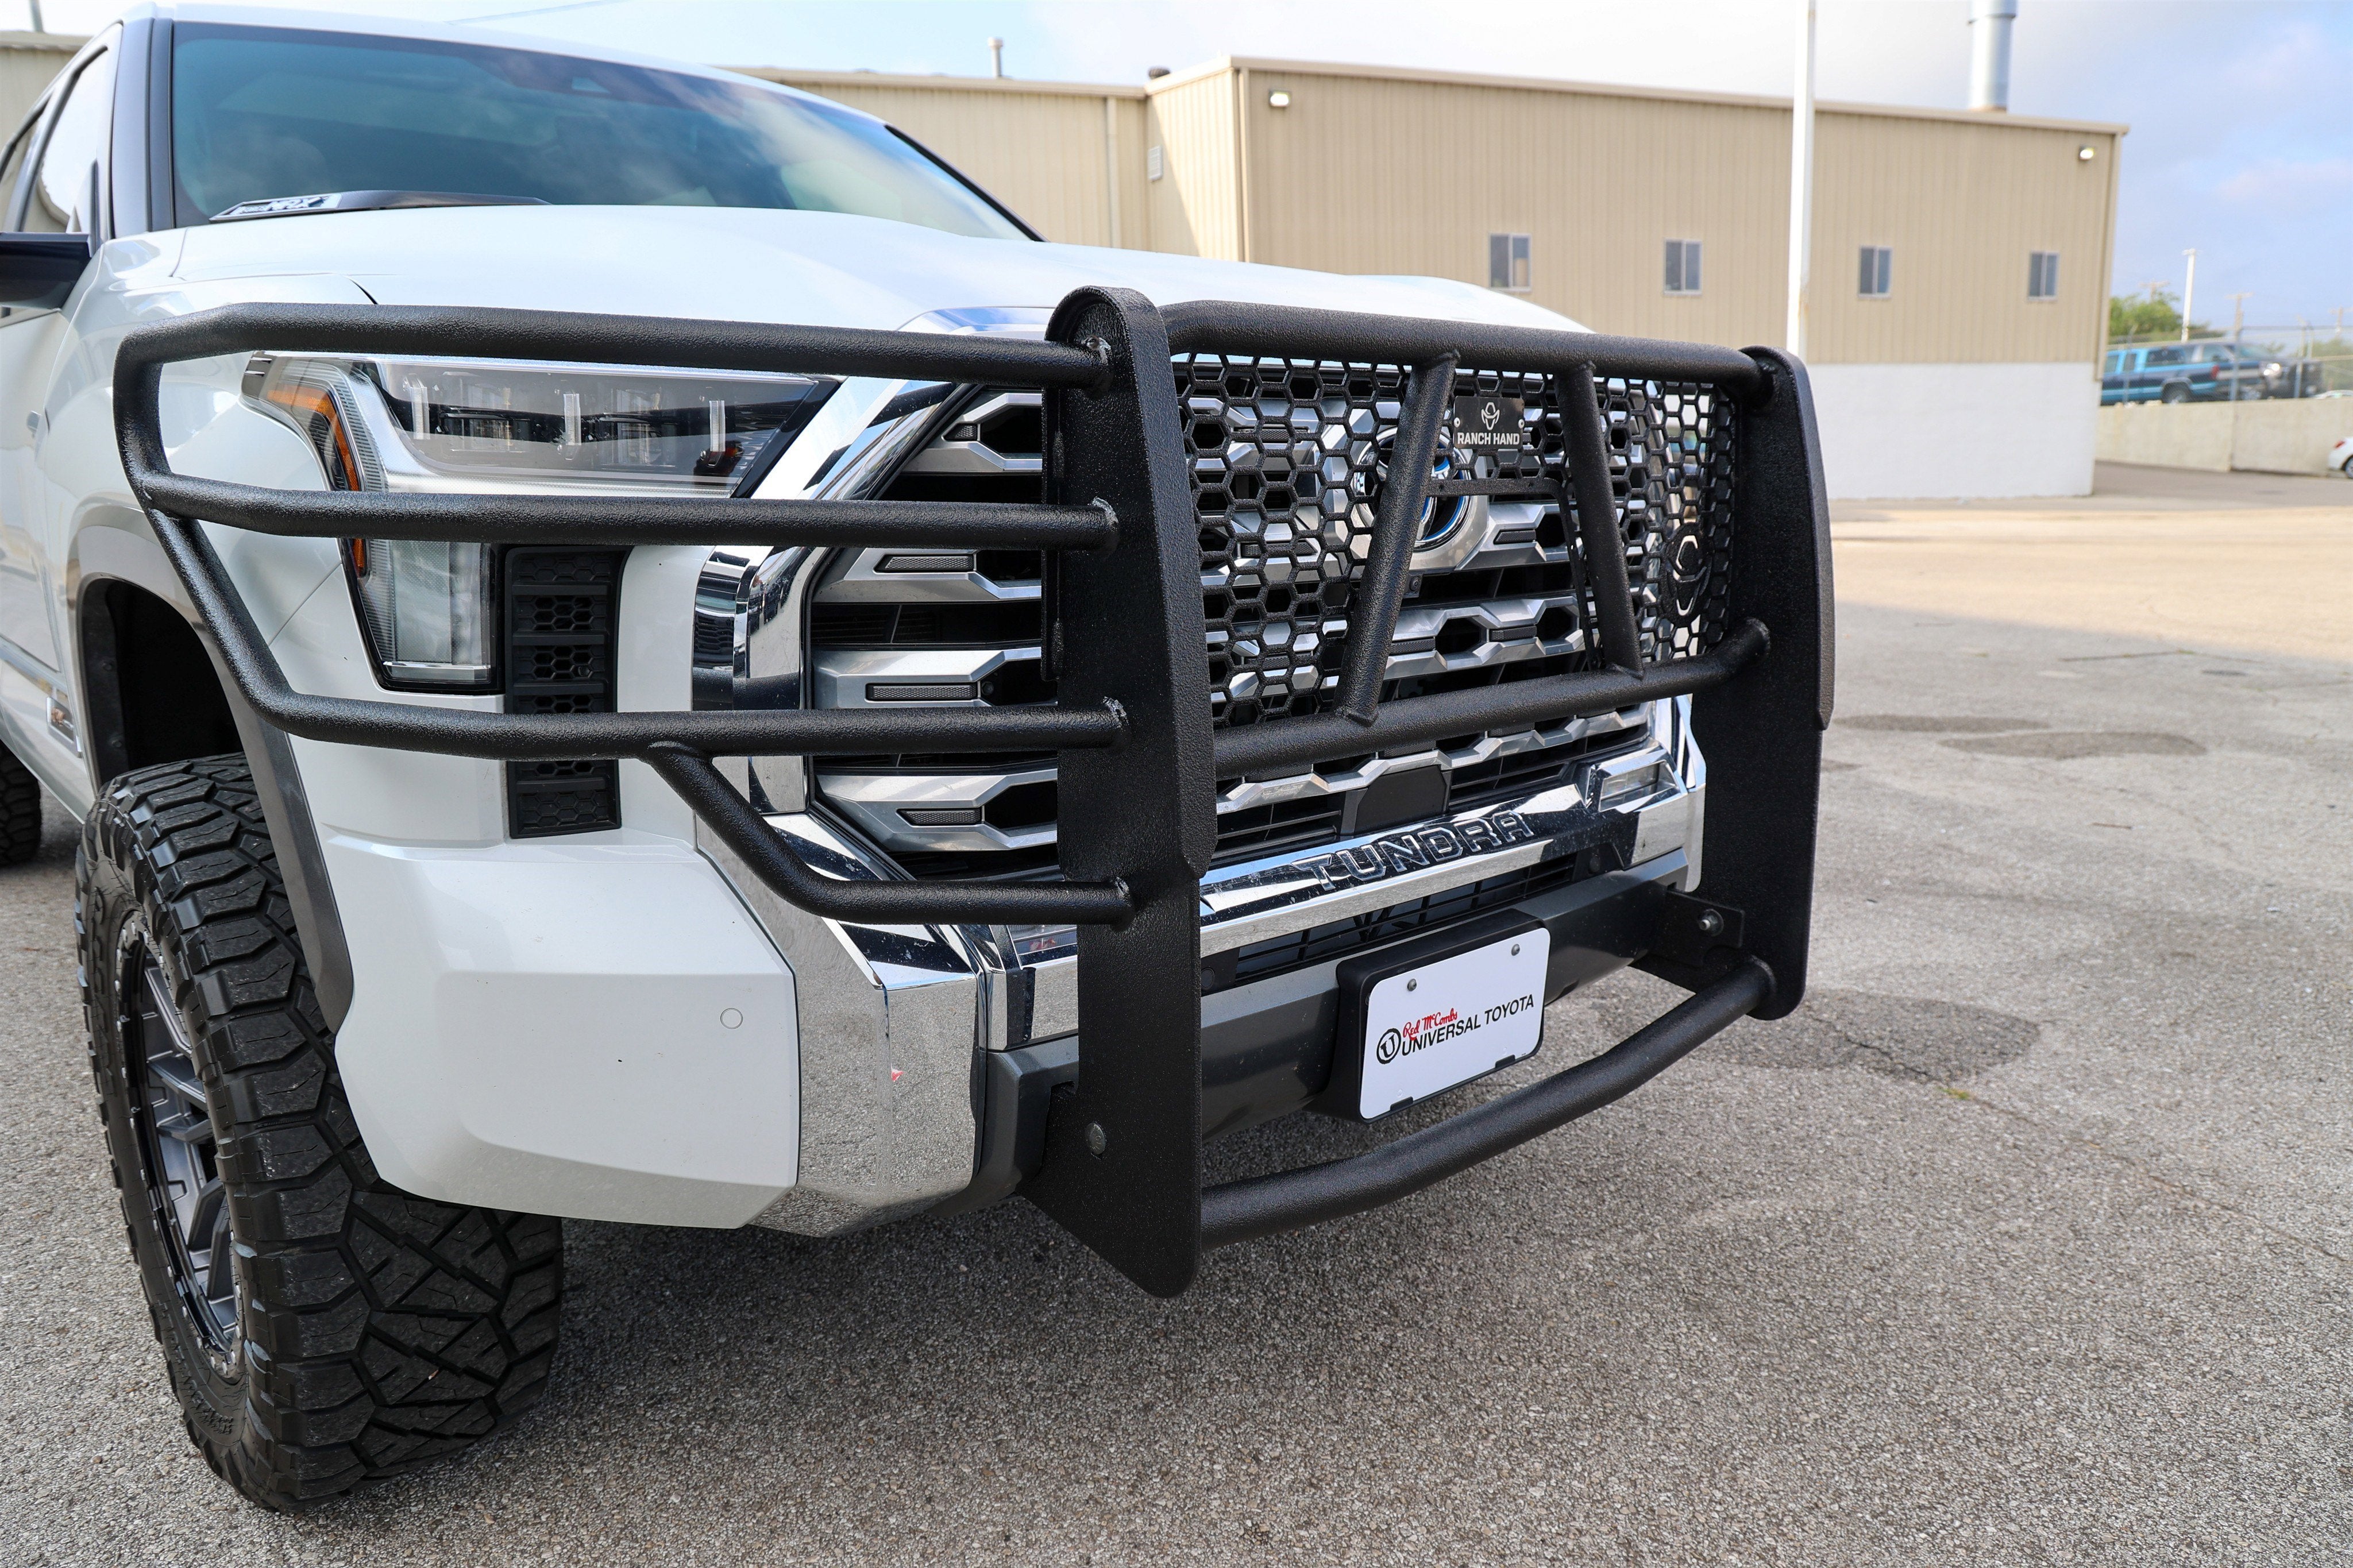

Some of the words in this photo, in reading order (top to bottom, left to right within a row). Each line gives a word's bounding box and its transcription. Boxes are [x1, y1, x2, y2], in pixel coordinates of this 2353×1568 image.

[1457, 432, 1491, 445] RANCH
[1493, 432, 1520, 445] HAND
[1290, 809, 1535, 891] TUNDRA
[1402, 1014, 1481, 1056] UNIVERSAL
[1484, 994, 1534, 1025] TOYOTA
[1403, 1019, 1421, 1040] Red
